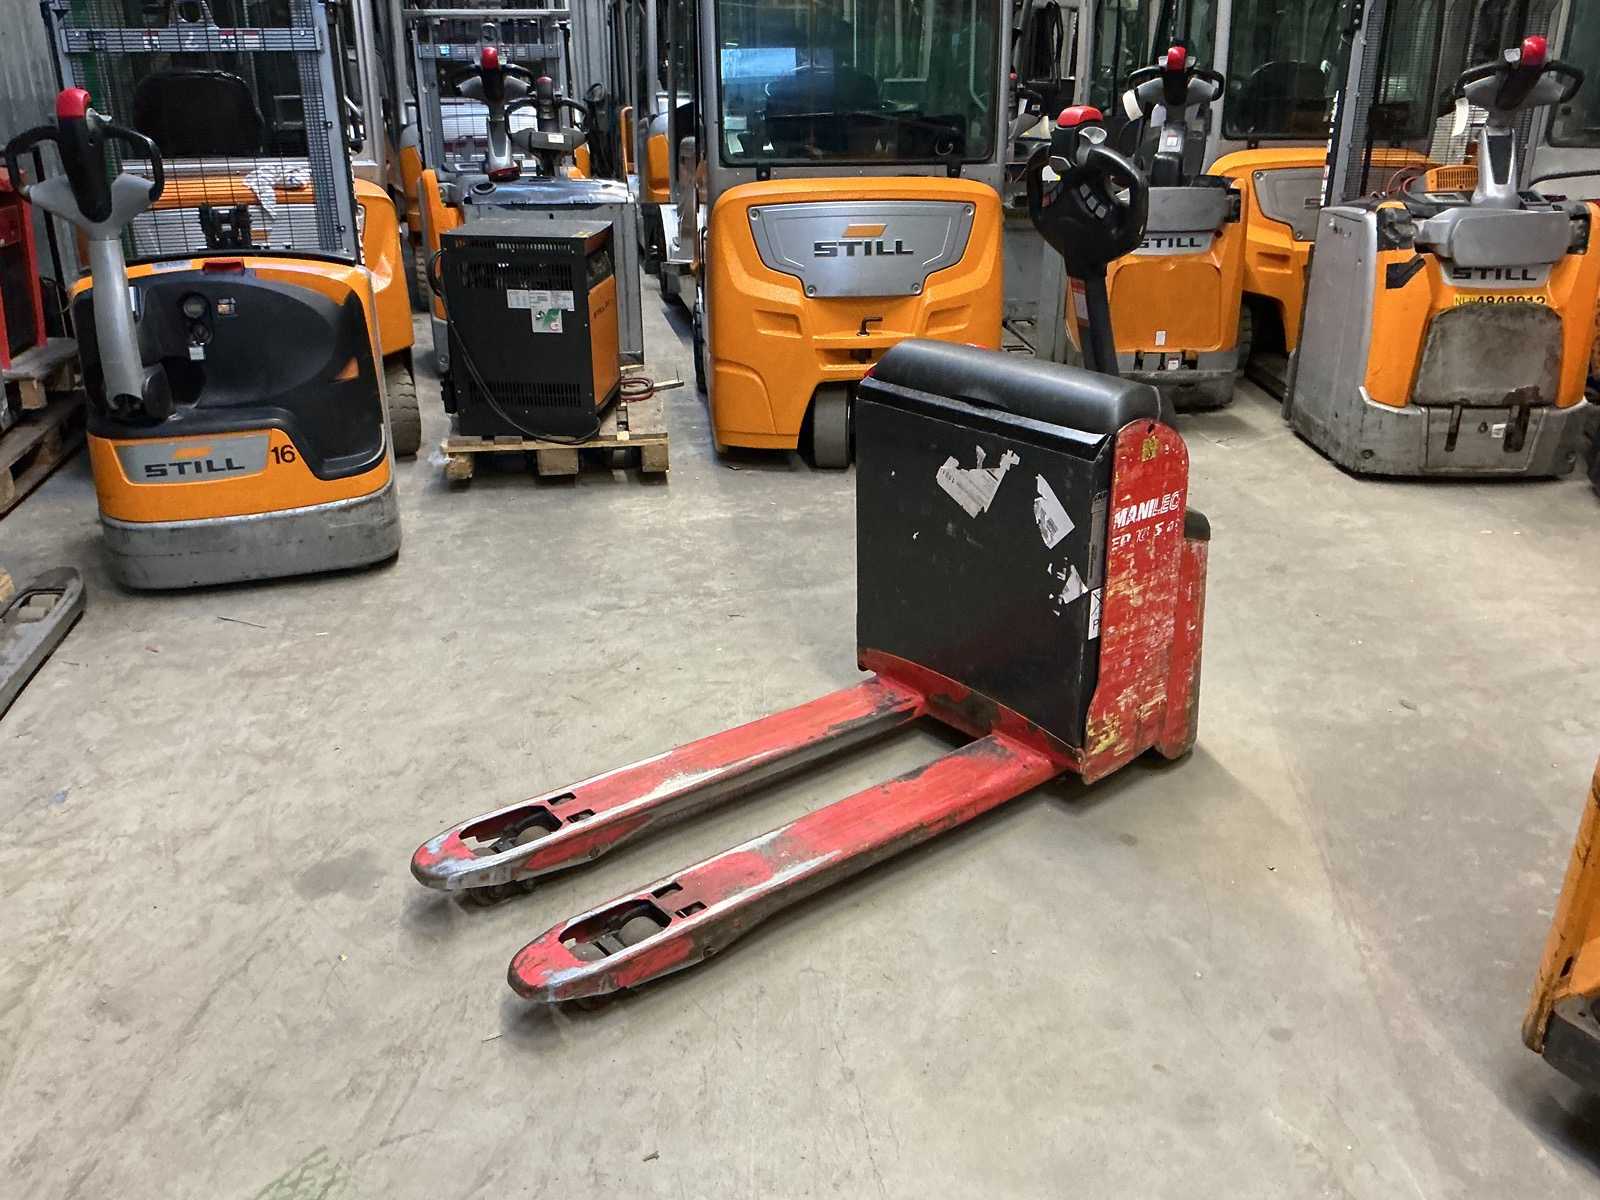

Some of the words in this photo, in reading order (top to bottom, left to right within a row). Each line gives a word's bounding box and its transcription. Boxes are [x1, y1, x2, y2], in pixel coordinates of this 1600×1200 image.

[813, 239, 914, 258] STILL
[1139, 237, 1202, 249] STILL
[1452, 266, 1537, 281] STILL
[271, 444, 296, 465] 16
[144, 458, 246, 478] STILL
